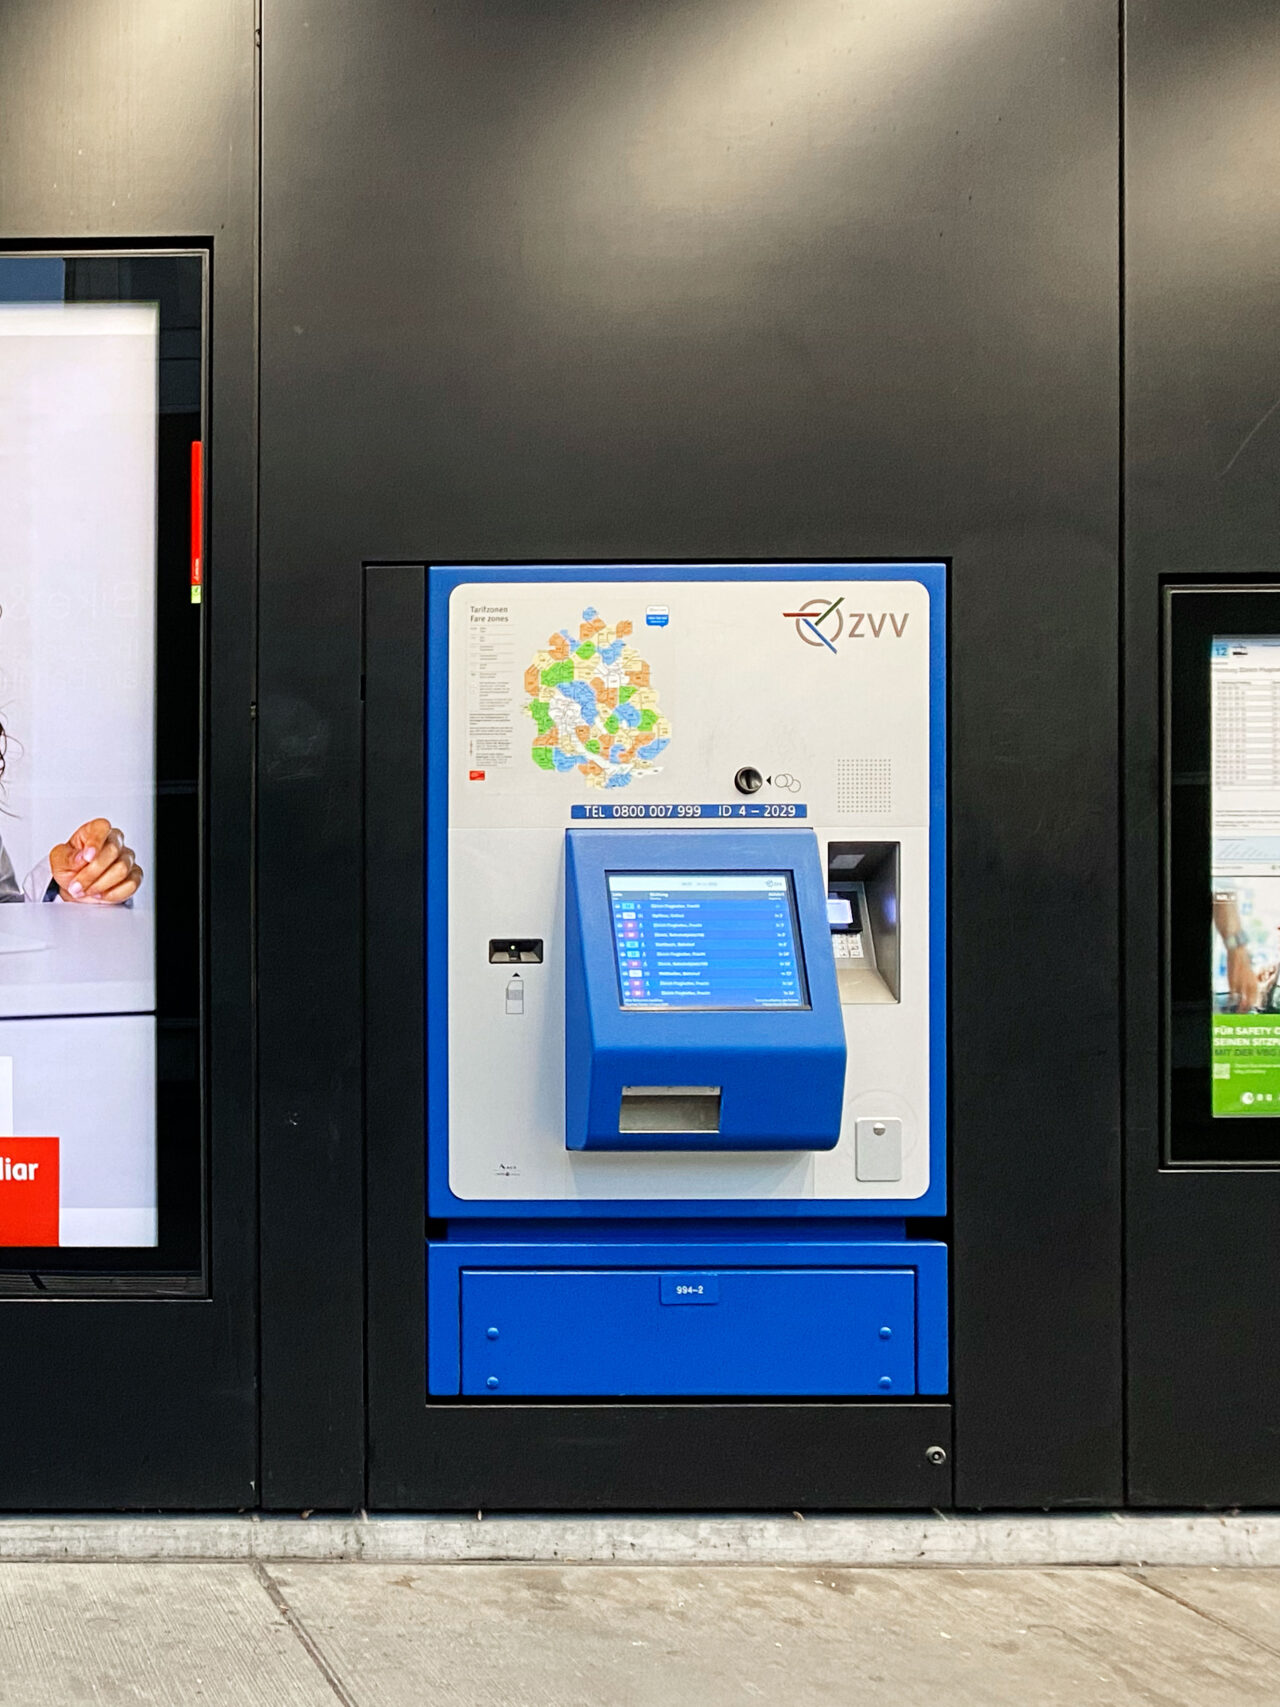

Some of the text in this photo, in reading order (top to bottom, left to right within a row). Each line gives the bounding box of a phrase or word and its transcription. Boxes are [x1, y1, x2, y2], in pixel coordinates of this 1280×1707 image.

[848, 612, 910, 638] ZVV
[584, 805, 605, 817] TEL
[612, 805, 645, 817] 0800
[649, 805, 672, 817] 007
[677, 805, 701, 817] 999
[719, 805, 732, 817] ID
[738, 805, 747, 817] 4
[763, 805, 796, 817] 2029
